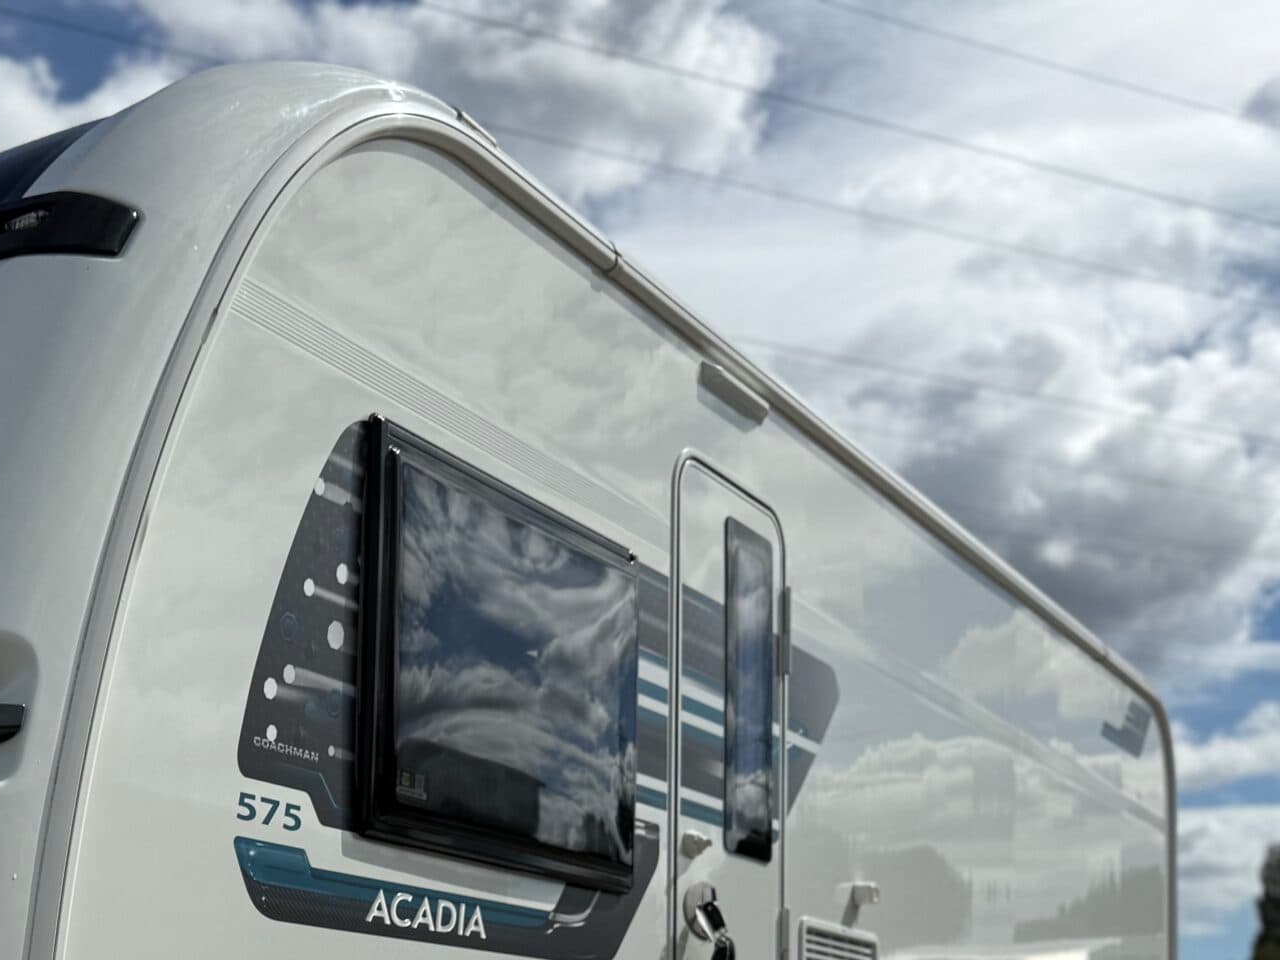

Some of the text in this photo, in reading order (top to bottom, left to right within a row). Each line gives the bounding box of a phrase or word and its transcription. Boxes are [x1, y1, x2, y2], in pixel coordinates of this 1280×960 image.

[253, 737, 319, 762] COACHMAN
[236, 792, 302, 831] 575
[365, 889, 487, 940] ACADIA
